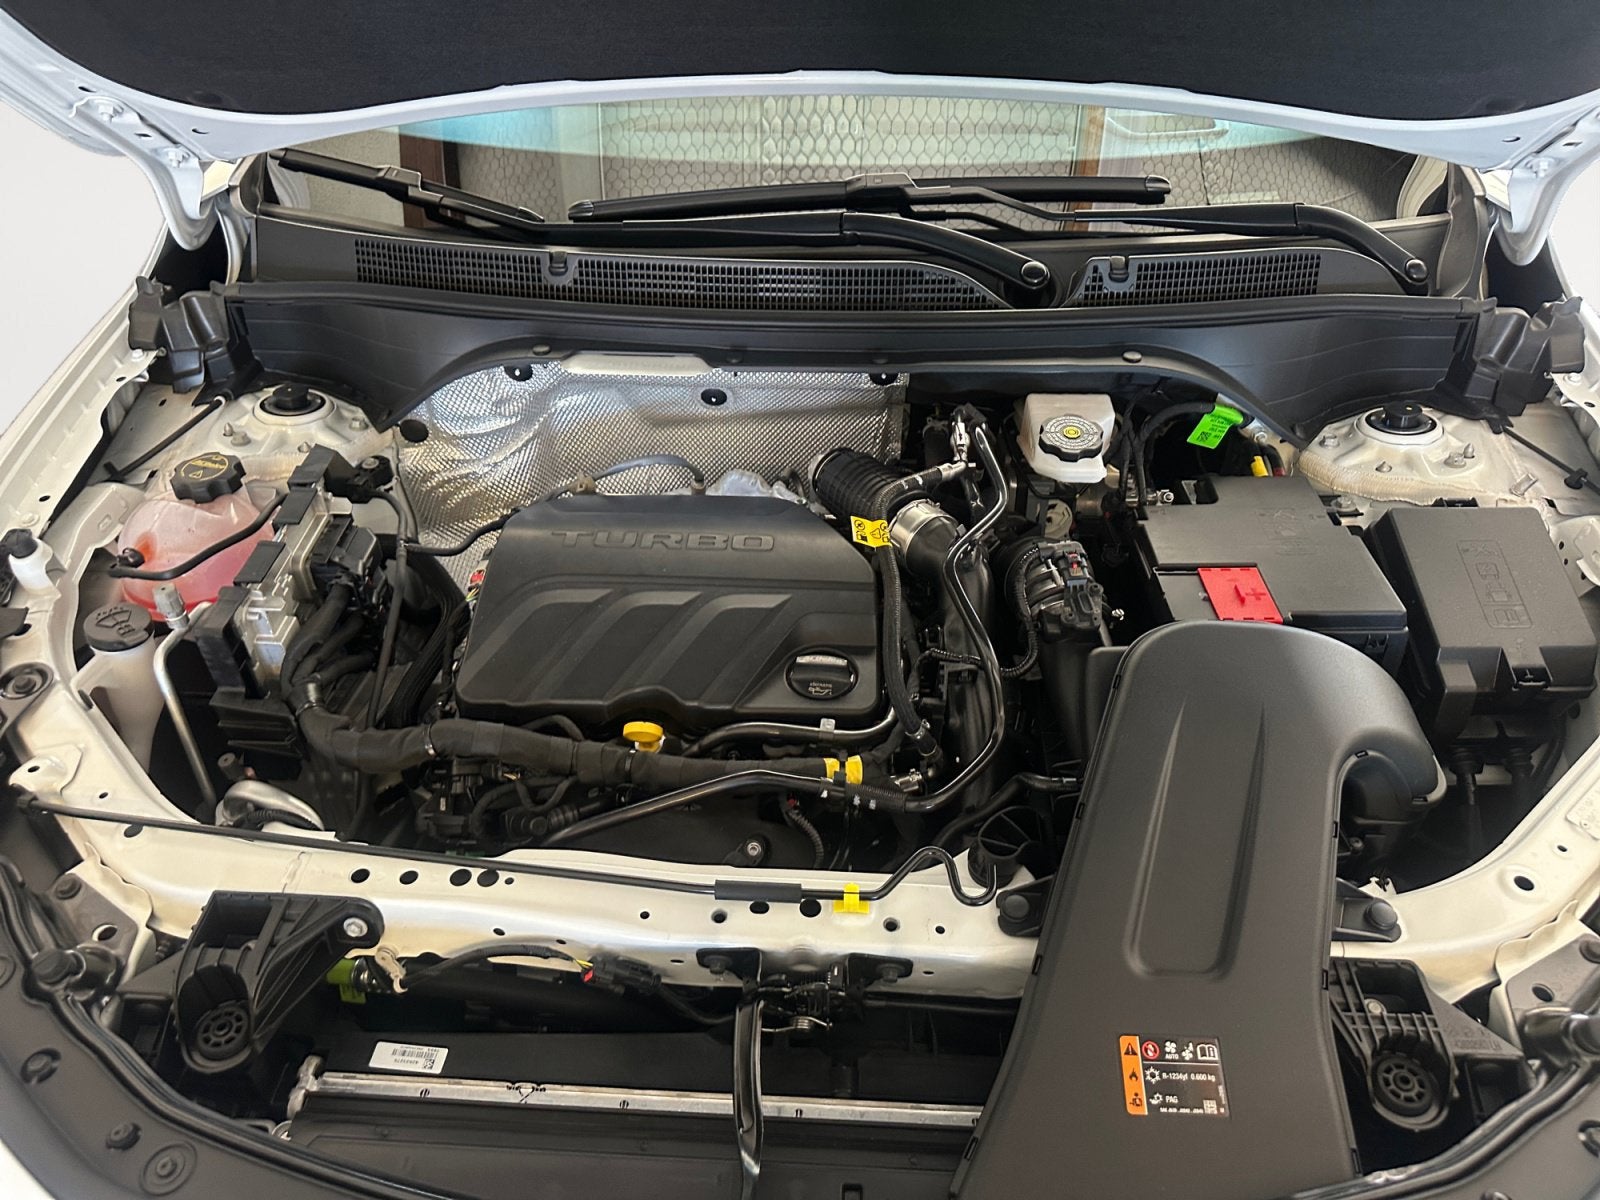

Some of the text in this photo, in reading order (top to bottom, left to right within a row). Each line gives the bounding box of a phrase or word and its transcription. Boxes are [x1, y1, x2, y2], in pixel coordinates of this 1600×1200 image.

[551, 530, 775, 552] TURBO
[1162, 1072, 1188, 1081] R-1234yf
[1207, 1073, 1216, 1082] kg
[1165, 1095, 1179, 1103] PAG
